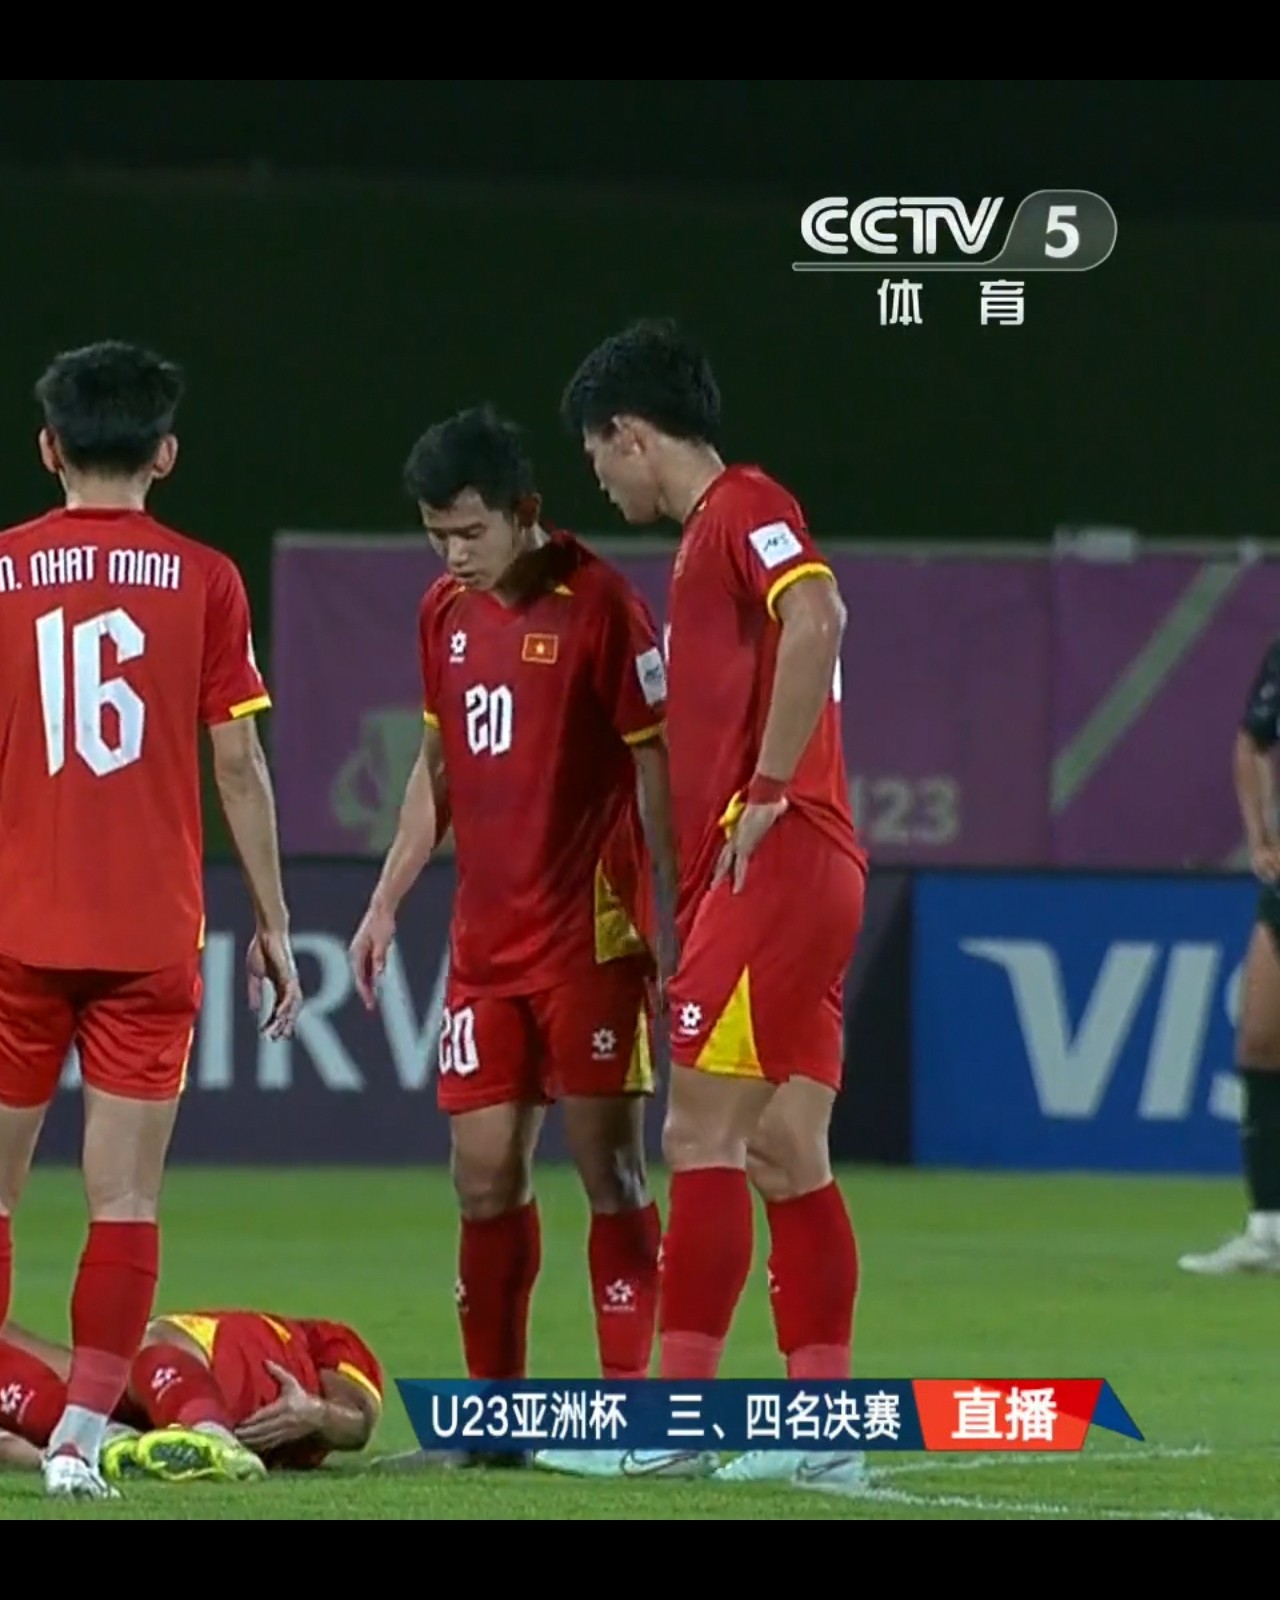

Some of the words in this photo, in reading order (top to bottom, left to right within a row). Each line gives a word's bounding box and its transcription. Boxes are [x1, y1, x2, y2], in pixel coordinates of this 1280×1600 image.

[30, 545, 99, 588] NHAT
[108, 548, 181, 590] MINH
[35, 605, 146, 778] 16
[464, 683, 514, 757] 20
[438, 1005, 480, 1077] 20
[957, 936, 1250, 1124] VI
